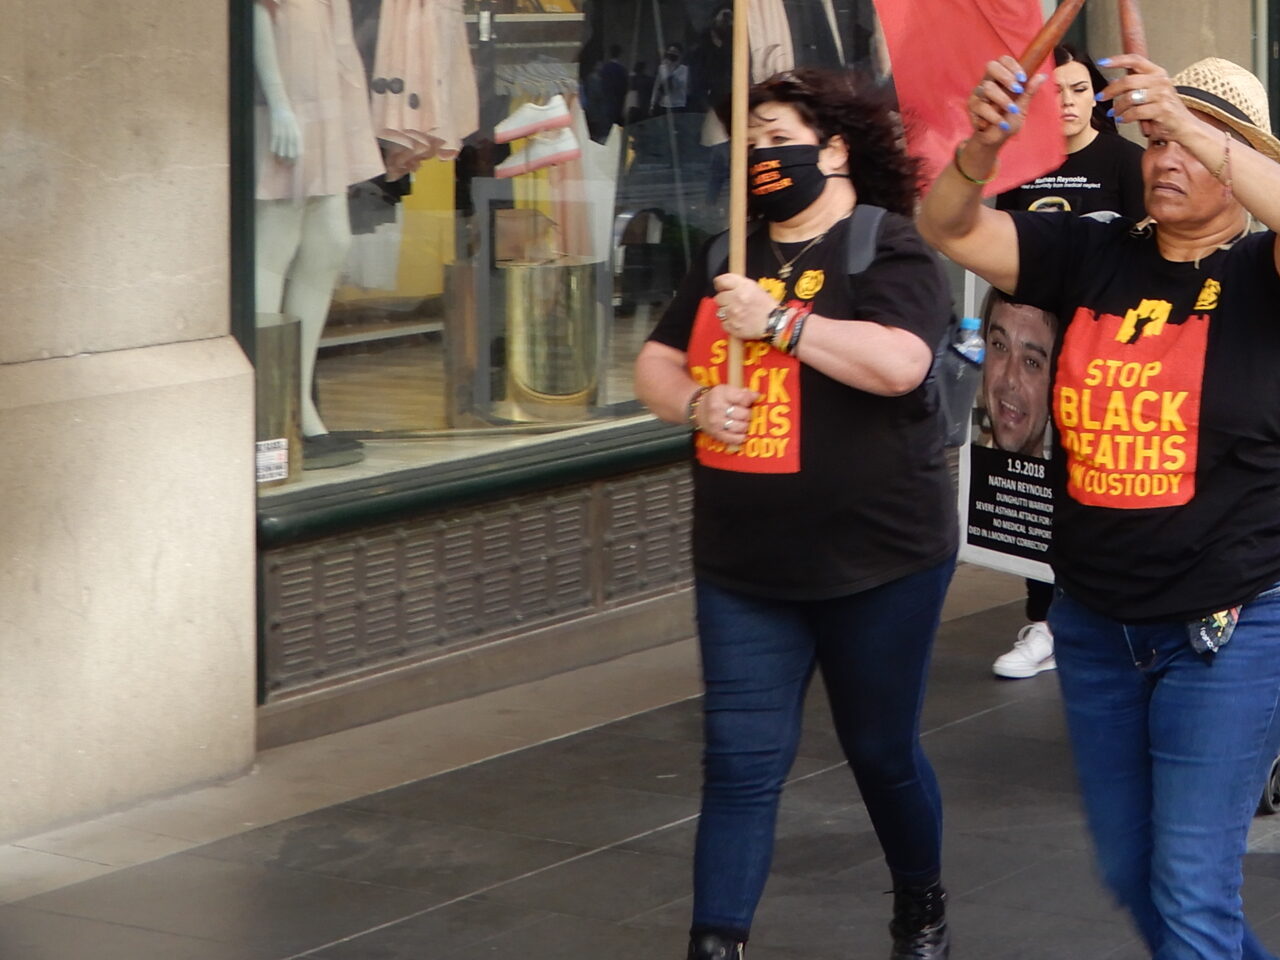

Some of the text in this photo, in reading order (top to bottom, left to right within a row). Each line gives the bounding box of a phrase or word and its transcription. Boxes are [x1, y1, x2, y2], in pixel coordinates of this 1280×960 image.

[710, 339, 770, 366] SOP
[1084, 358, 1163, 388] STOP
[1060, 386, 1189, 433] BLACK
[1007, 458, 1045, 478] 1.9.2018
[988, 475, 1053, 499] NATHAN REYNOLDS
[1084, 469, 1184, 497] CUSTODY
[975, 501, 995, 514] SEVERE
[995, 505, 1018, 518] ASTHMA
[1018, 511, 1038, 523] ATTACK
[968, 525, 980, 536] DIED
[981, 528, 988, 538] IN
[993, 518, 1002, 528] NO
[1002, 521, 1026, 534] MEDICAL
